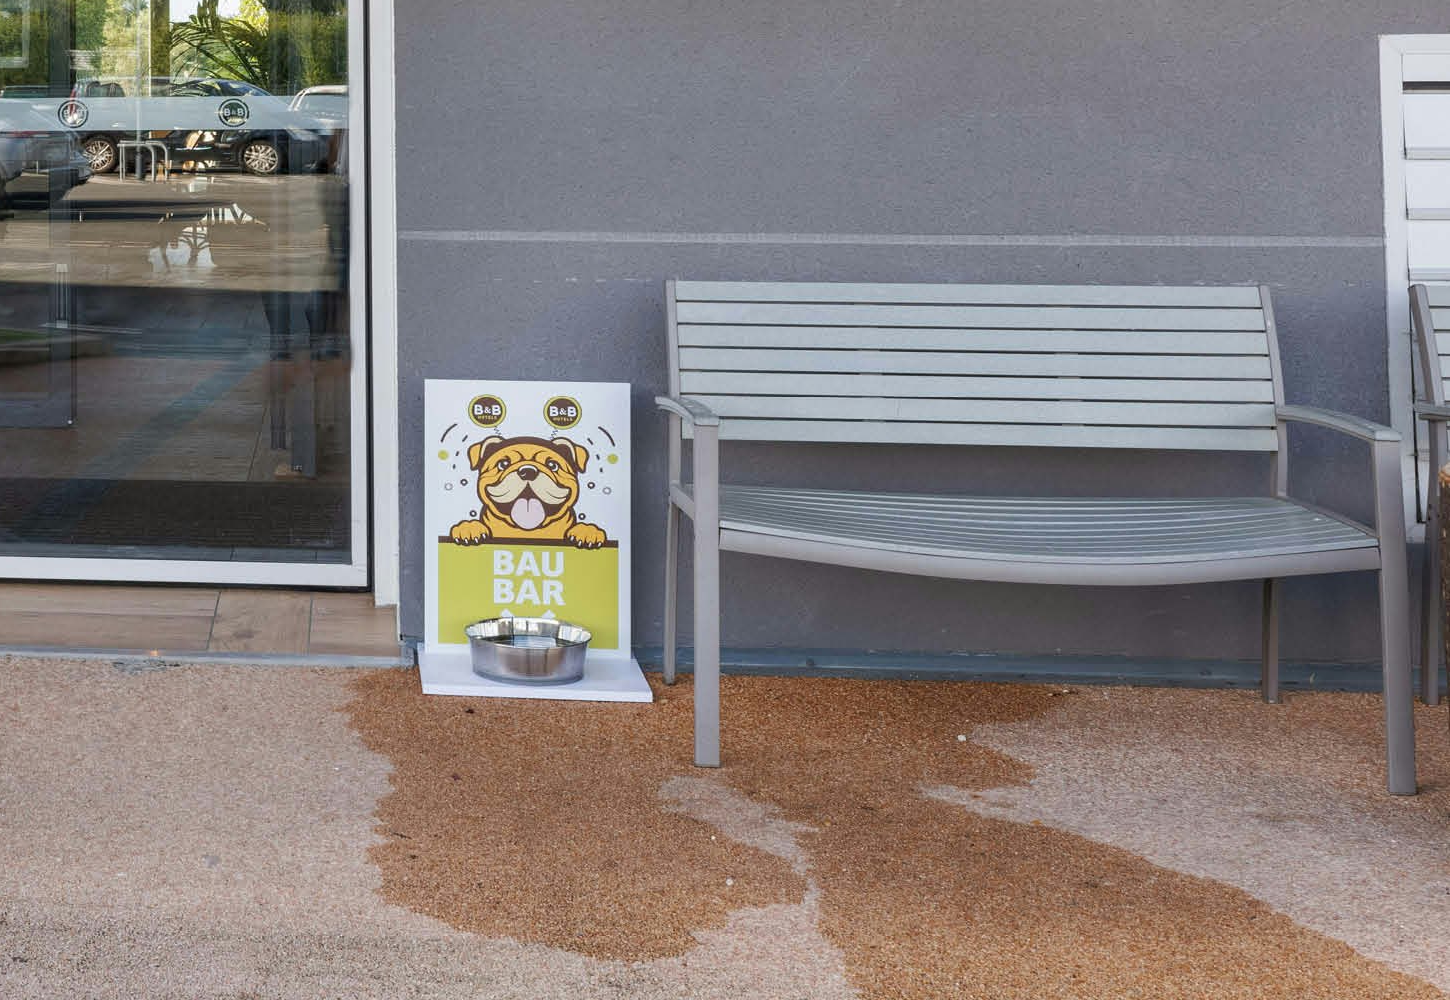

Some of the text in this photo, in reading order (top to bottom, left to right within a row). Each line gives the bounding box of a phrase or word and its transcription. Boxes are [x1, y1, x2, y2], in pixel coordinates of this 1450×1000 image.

[474, 404, 502, 416] B&B
[549, 406, 577, 417] B&B
[493, 550, 565, 577] BAU
[493, 578, 567, 606] BAR
